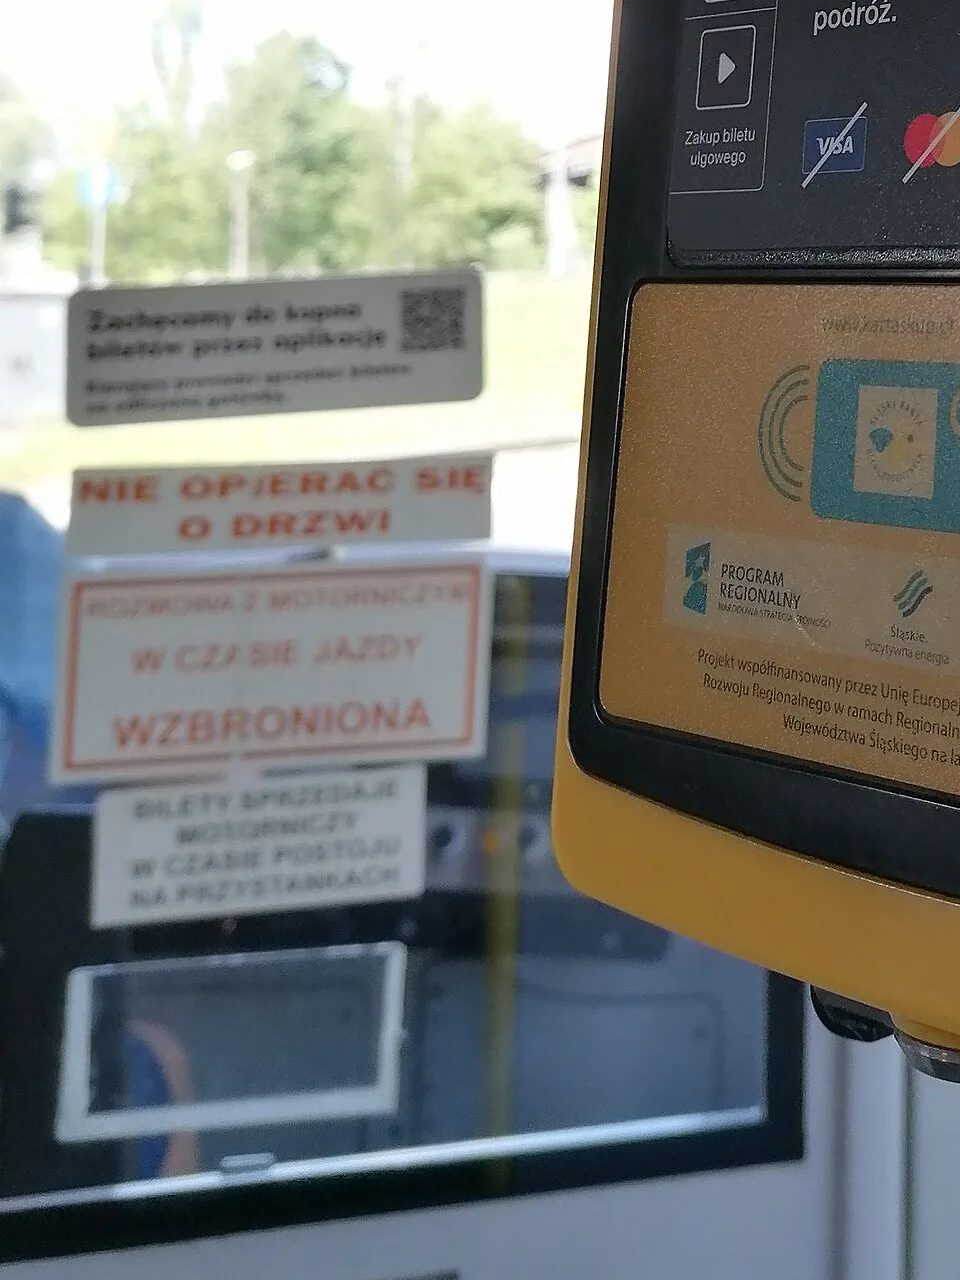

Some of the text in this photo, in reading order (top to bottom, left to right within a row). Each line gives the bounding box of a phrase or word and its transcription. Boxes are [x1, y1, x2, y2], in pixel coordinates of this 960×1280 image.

[685, 125, 756, 147] Zakup biletu
[816, 136, 854, 155] VISA
[690, 149, 747, 169] ulgowego
[77, 474, 160, 504] NIE
[178, 508, 390, 540] O DRZWI
[721, 563, 784, 587] PROGRAM
[719, 581, 801, 610] REGIONALNY
[130, 648, 165, 674] W
[315, 633, 422, 666] JAZDY
[864, 638, 949, 667] Pozytywna energia
[698, 648, 734, 670] Projekt
[738, 657, 842, 692] współfinansowany
[845, 679, 877, 696] przez
[881, 682, 909, 706] Unię
[703, 673, 750, 698] Rozwoju
[752, 682, 831, 715] Regionalnego
[847, 706, 893, 726] ramach
[111, 697, 432, 750] WZBRONIONA
[783, 714, 866, 746] Województwa
[869, 727, 928, 760] Śląskiego
[931, 749, 947, 763] na
